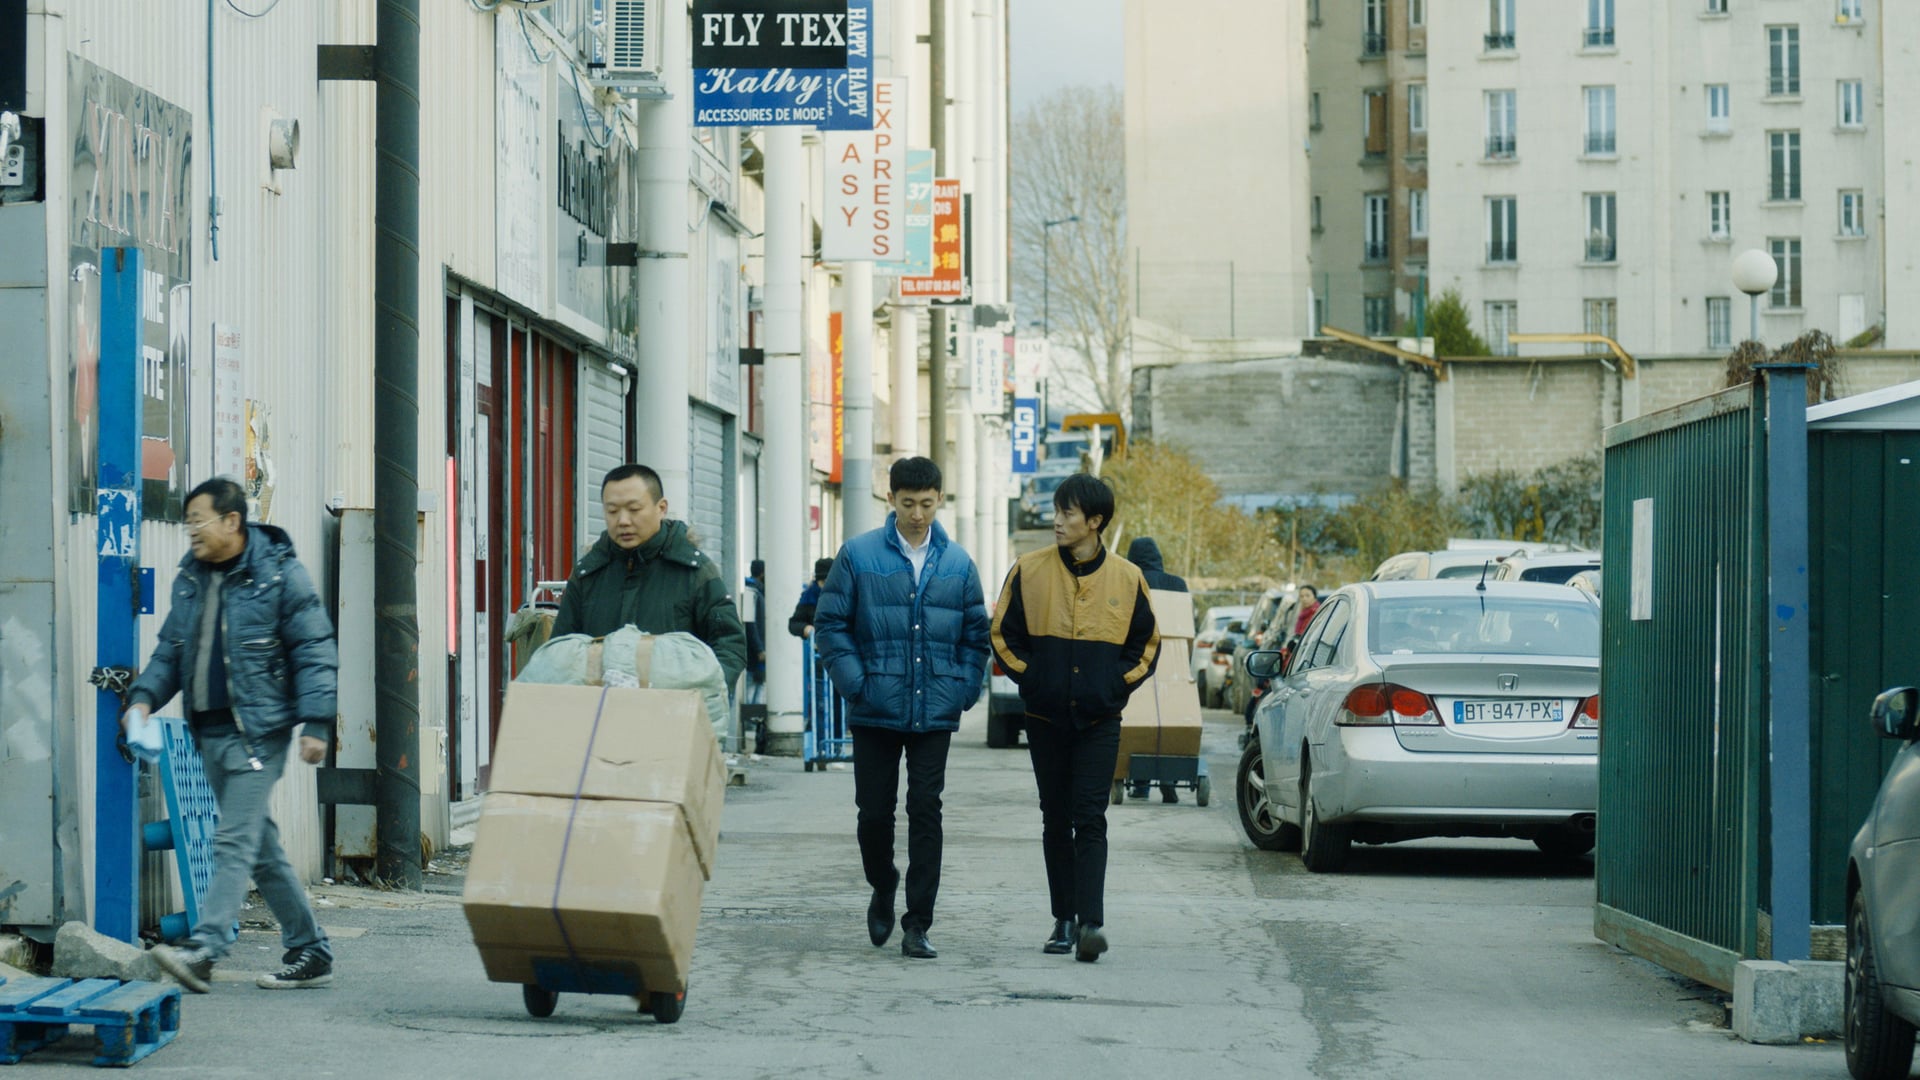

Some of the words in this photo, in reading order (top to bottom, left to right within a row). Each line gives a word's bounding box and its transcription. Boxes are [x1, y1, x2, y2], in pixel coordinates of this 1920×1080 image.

[702, 13, 765, 46] FLY
[776, 13, 846, 46] TEX
[848, 8, 867, 58] HAPPY
[699, 68, 823, 105] Kathy
[848, 67, 867, 118] HAPPY
[698, 108, 772, 122] ACCESSOIRES
[775, 108, 790, 121] DE
[793, 107, 825, 121] MODE
[872, 83, 892, 256] EXPRESS
